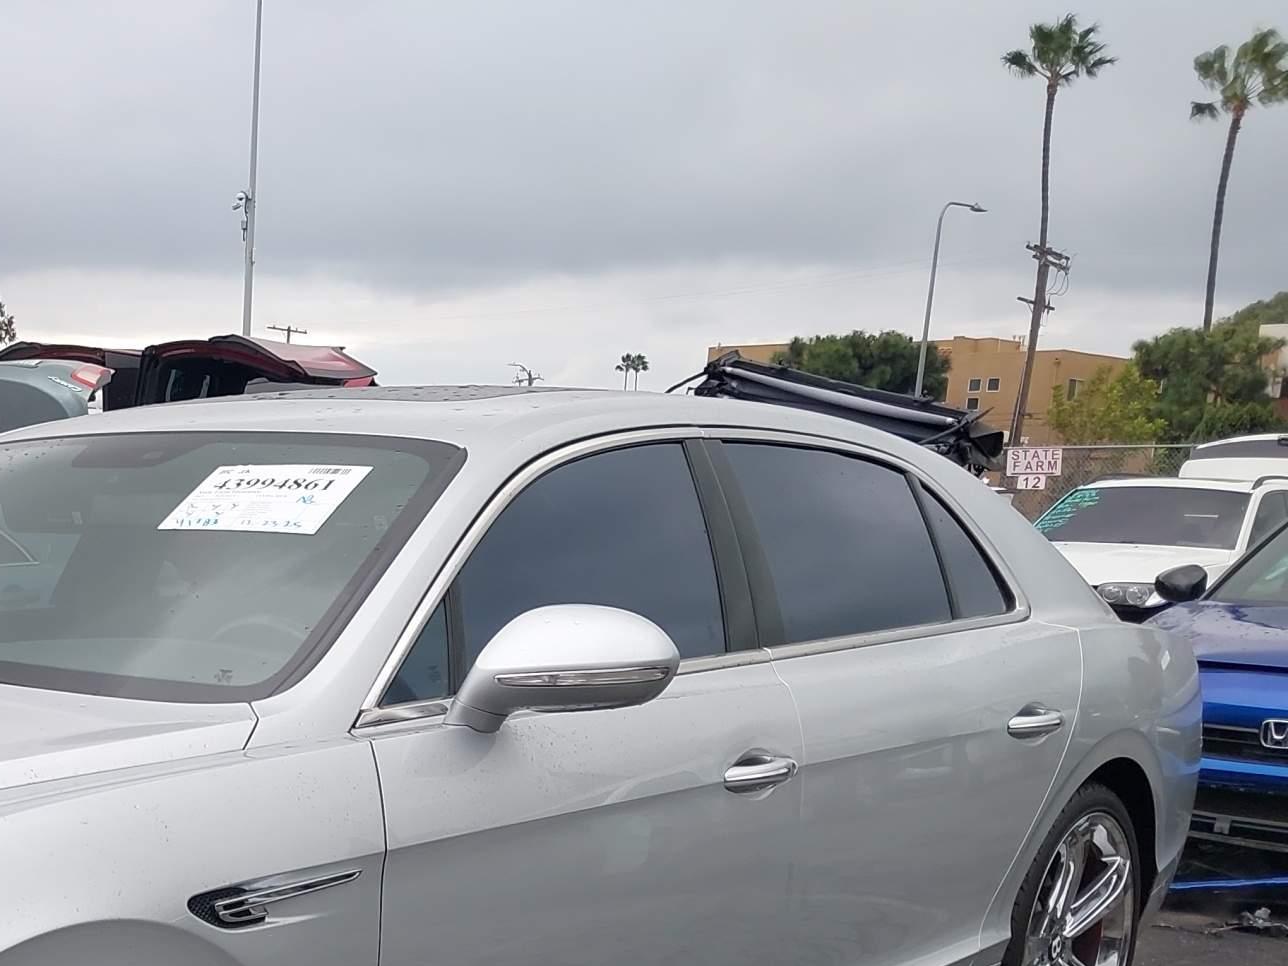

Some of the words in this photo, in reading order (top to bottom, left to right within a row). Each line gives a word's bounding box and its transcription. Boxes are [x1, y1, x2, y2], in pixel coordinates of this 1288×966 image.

[1011, 450, 1060, 460] STATE
[1012, 461, 1057, 471] FARM
[213, 477, 337, 491] 43994861
[1023, 476, 1041, 489] 12
